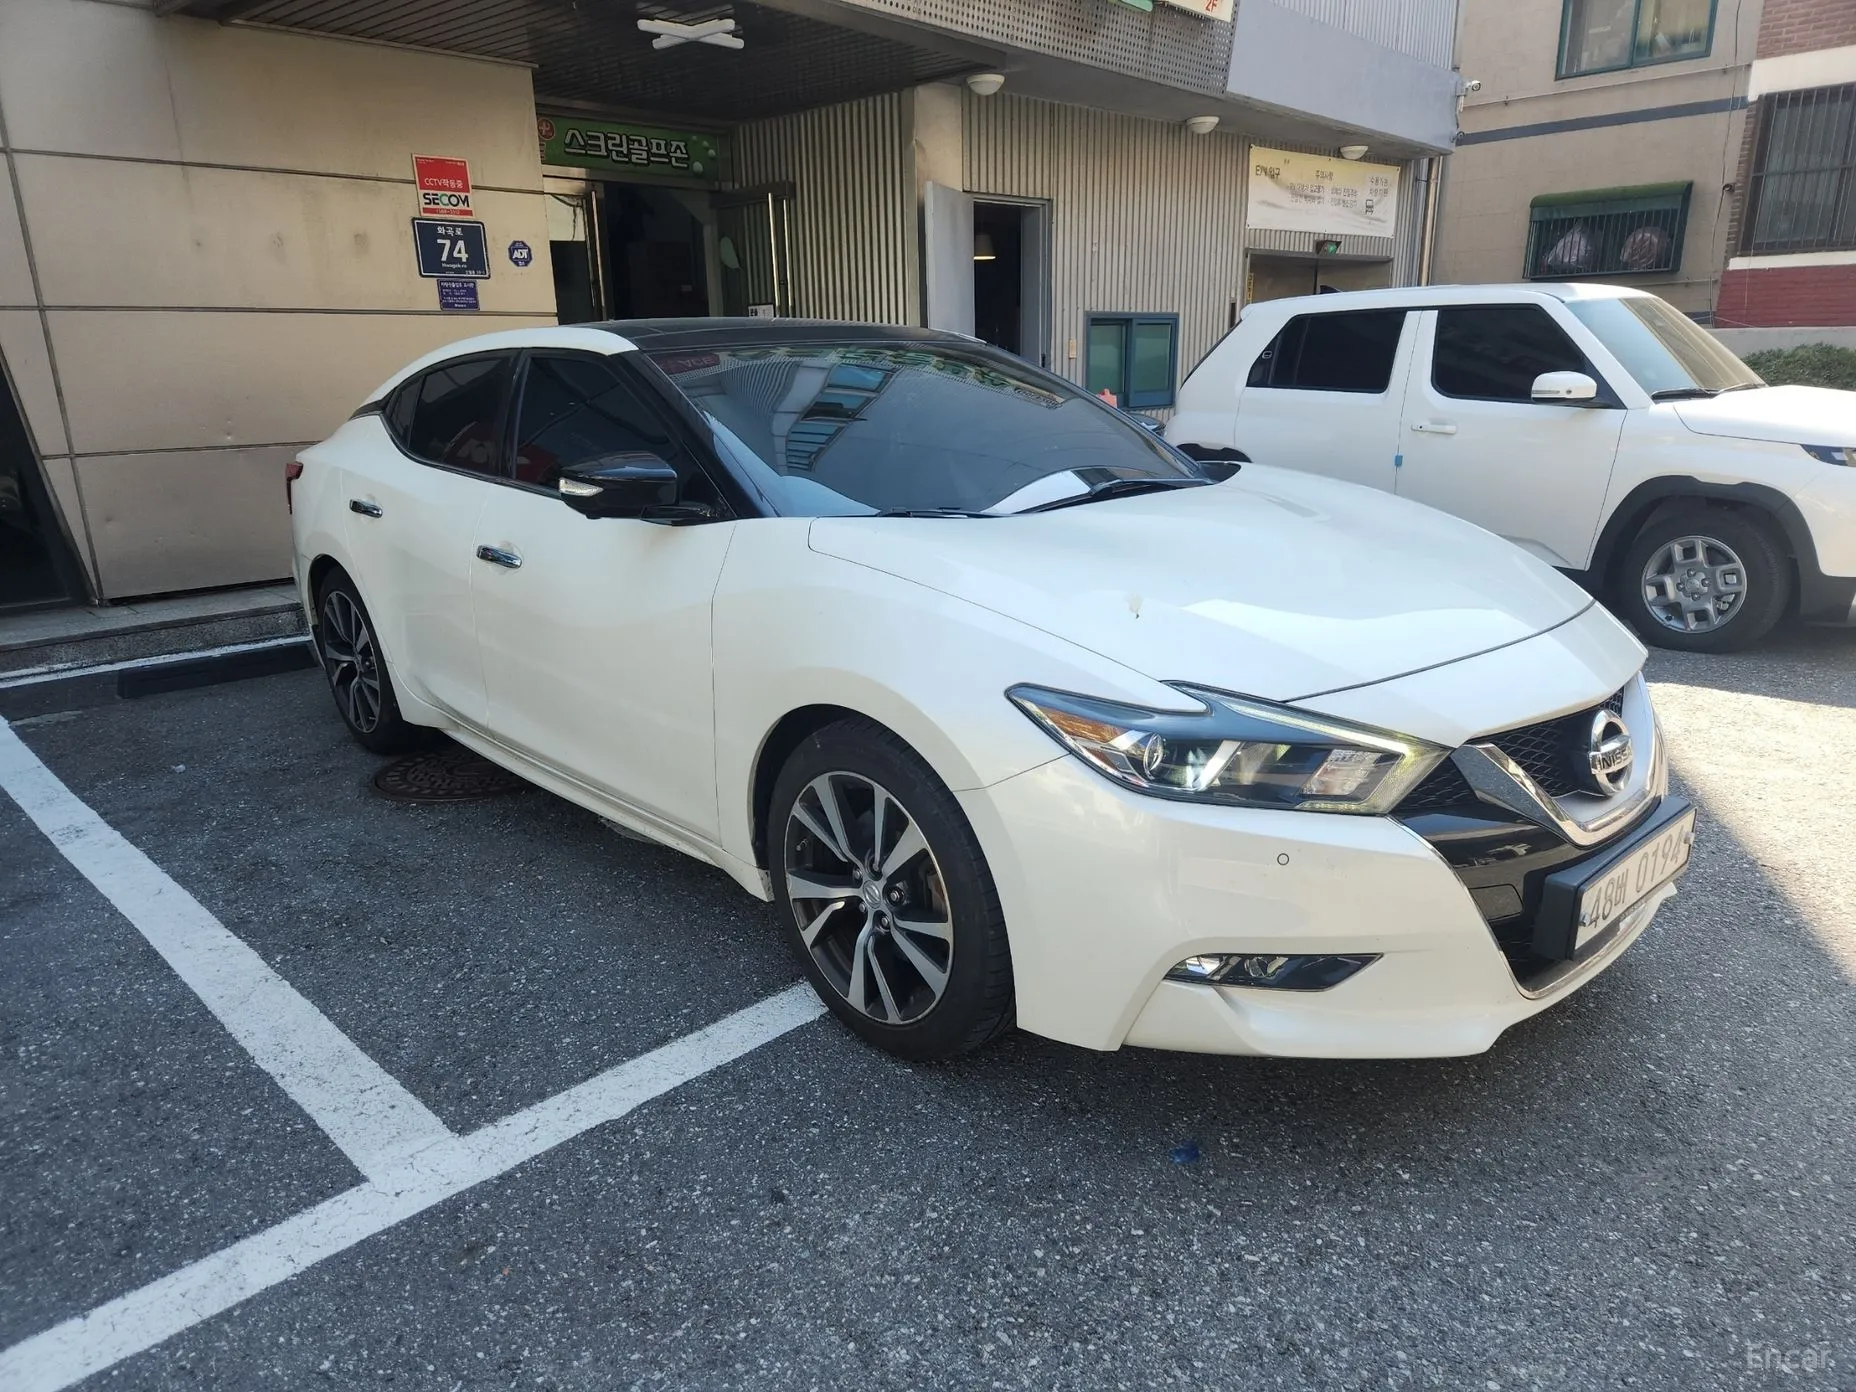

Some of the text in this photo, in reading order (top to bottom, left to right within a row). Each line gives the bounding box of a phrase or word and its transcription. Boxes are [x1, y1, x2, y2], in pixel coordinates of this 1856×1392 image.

[564, 128, 690, 168] 스크린골프존
[424, 177, 464, 189] CCTV작동중
[422, 192, 470, 208] SECOM
[437, 226, 464, 236] 화곡로
[436, 238, 469, 262] 74
[512, 248, 528, 259] ADT
